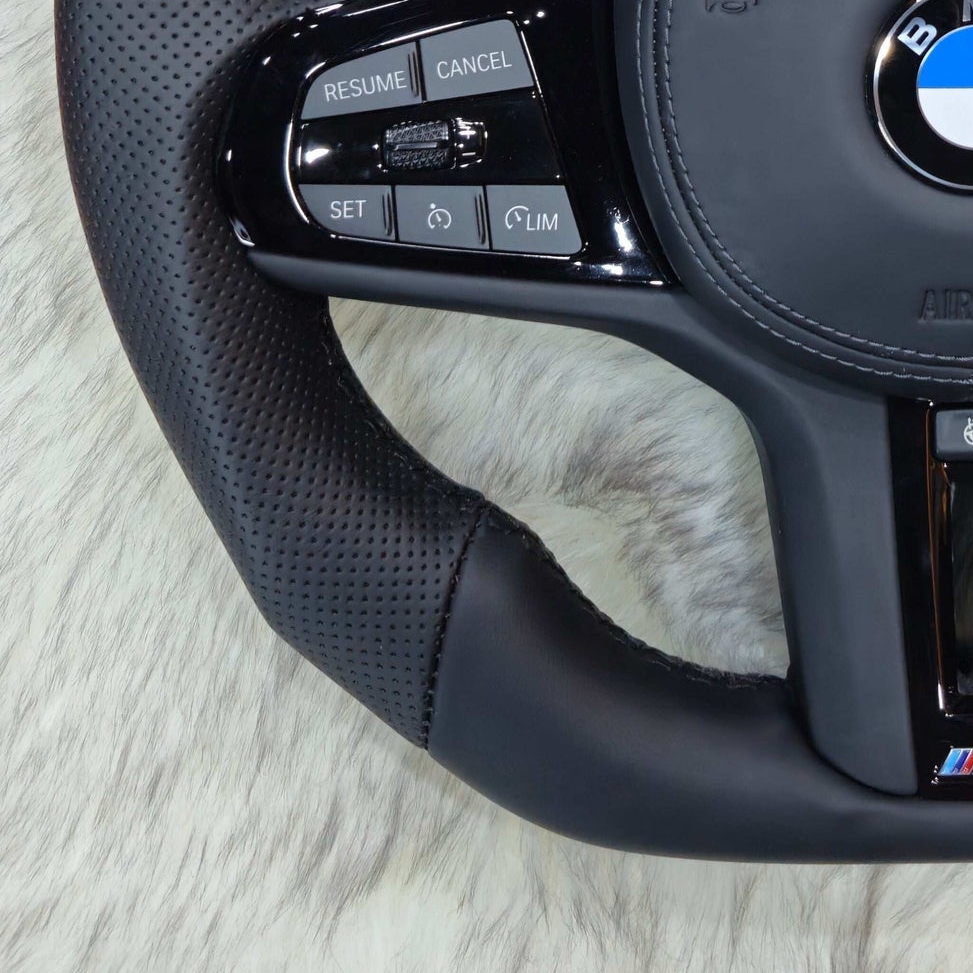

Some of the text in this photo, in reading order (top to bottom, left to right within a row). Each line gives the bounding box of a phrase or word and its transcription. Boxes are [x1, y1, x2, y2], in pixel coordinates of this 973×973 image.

[436, 50, 513, 80] CANCEL
[324, 70, 407, 102] RESUME
[330, 199, 367, 219] SET
[526, 212, 559, 231] LIM
